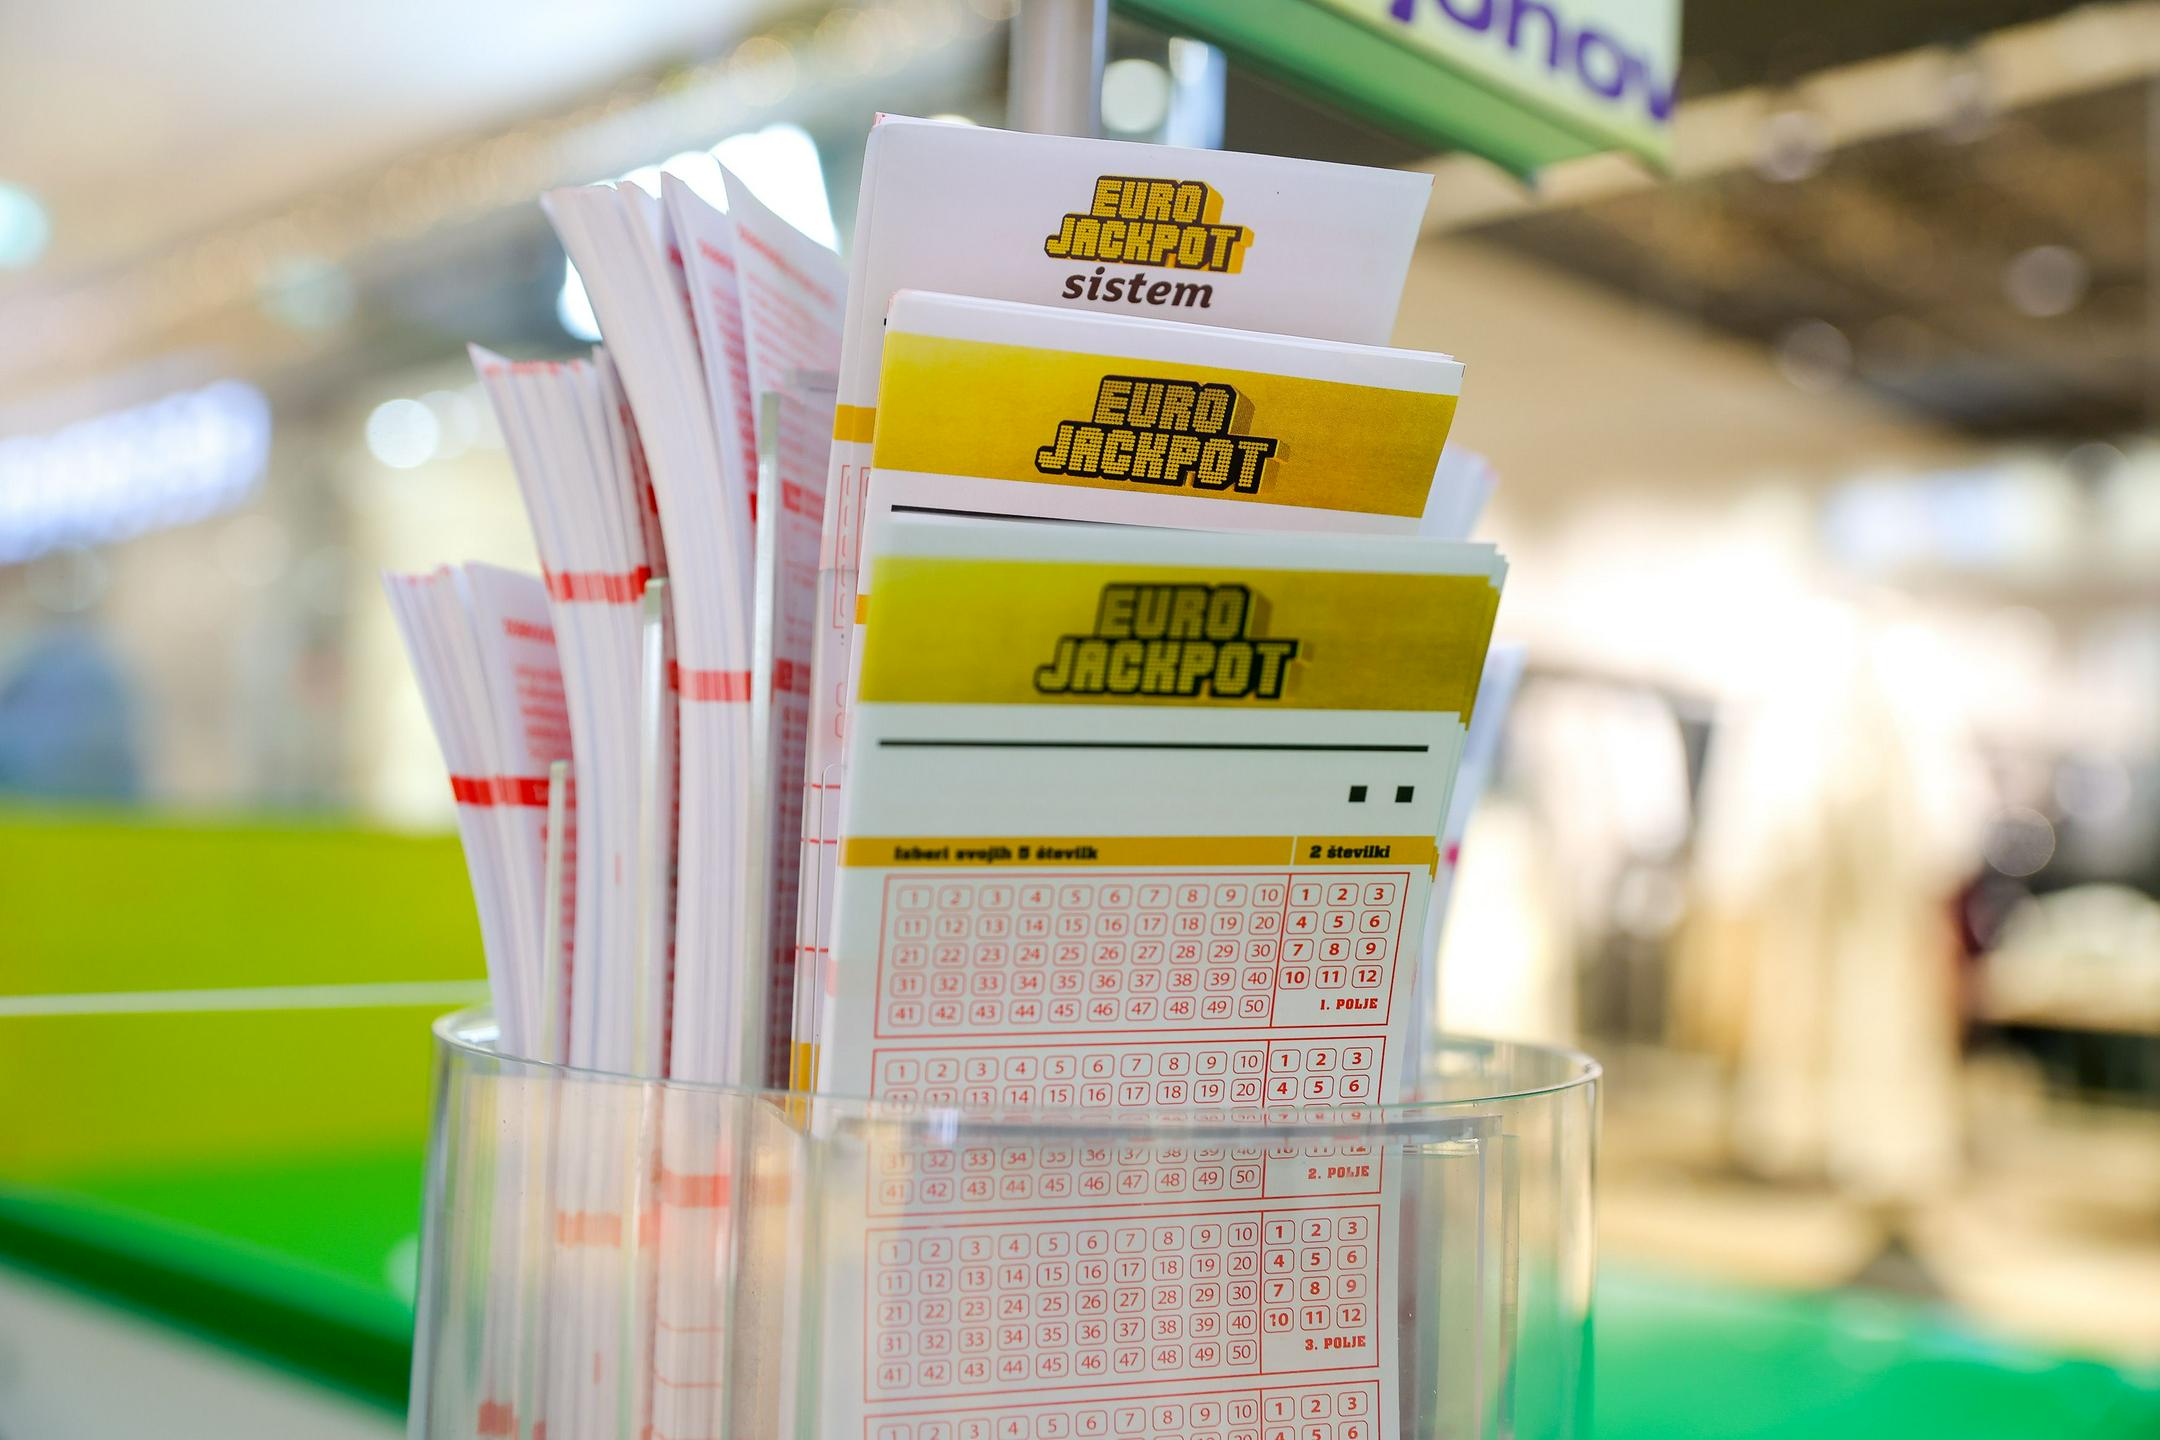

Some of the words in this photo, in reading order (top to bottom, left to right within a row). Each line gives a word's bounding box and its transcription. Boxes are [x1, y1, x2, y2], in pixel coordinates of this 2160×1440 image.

[1090, 176, 1210, 224] EURO
[1044, 214, 1245, 272] JACKPOT
[1062, 266, 1213, 308] sistem
[1093, 375, 1238, 434] EURO
[1035, 420, 1278, 493] JACKPOT
[1095, 584, 1253, 638] EURO
[1034, 635, 1299, 699] JACKPOT
[956, 846, 1012, 864] svojih
[1018, 846, 1030, 860] 5
[1036, 846, 1098, 860] številk
[1310, 845, 1322, 858] 2
[1327, 844, 1391, 858] številki
[991, 889, 1002, 905] 3
[1030, 890, 1041, 903] 4
[1071, 889, 1081, 904] 5
[1109, 889, 1121, 904] 6
[1149, 888, 1160, 903] 7
[1186, 888, 1198, 903] 8
[1225, 888, 1236, 902] 9
[1261, 888, 1278, 902] 10
[1336, 887, 1348, 901] 2
[1373, 887, 1384, 900] 3
[985, 918, 1003, 933] 13
[1025, 919, 1043, 931] 14
[1065, 917, 1083, 932] 15
[1104, 917, 1122, 931] 16
[1143, 916, 1161, 931] 17
[1182, 916, 1199, 931] 18
[1219, 916, 1237, 930] 19
[1254, 915, 1274, 929] 20
[1295, 915, 1307, 928] 4
[1332, 915, 1343, 928] 5
[1368, 914, 1380, 928] 6
[979, 947, 1000, 962] 23
[1020, 946, 1040, 961] 24
[1059, 946, 1079, 961] 25
[1098, 946, 1119, 960] 26
[1137, 944, 1157, 960] 27
[1175, 944, 1196, 959] 28
[1213, 943, 1234, 958] 29
[1251, 943, 1271, 957] 30
[1292, 943, 1303, 956] 7
[1328, 942, 1339, 956] 8
[1365, 941, 1376, 955] 9
[979, 975, 998, 990] 33
[1019, 975, 1037, 989] 34
[1057, 974, 1076, 989] 35
[1096, 974, 1116, 988] 36
[1134, 973, 1154, 987] 37
[1172, 972, 1192, 987] 38
[1210, 972, 1230, 986] 39
[1247, 971, 1267, 984] 40
[1285, 970, 1305, 984] 10
[1321, 970, 1339, 983] 11
[1358, 969, 1377, 982] 12
[975, 1004, 995, 1019] 43
[1014, 1004, 1035, 1017] 44
[1053, 1003, 1074, 1017] 45
[1092, 1002, 1113, 1016] 46
[1130, 1001, 1151, 1015] 47
[1169, 1000, 1189, 1014] 48
[1206, 1000, 1227, 1013] 49
[1244, 999, 1264, 1013] 50
[1336, 998, 1378, 1009] POLJE
[1315, 1052, 1326, 1066] 2
[1351, 1051, 1362, 1064] 3
[1276, 1081, 1288, 1095] 4
[1313, 1080, 1323, 1094] 5
[1348, 1079, 1359, 1092] 6
[1308, 1168, 1321, 1179] 2.
[1328, 1166, 1369, 1178] POLJE
[1310, 1223, 1321, 1237] 2
[1347, 1220, 1357, 1235] 3
[971, 1240, 980, 1256] 3
[1008, 1238, 1019, 1252] 4
[1047, 1236, 1058, 1251] 5
[1086, 1234, 1097, 1249] 6
[1125, 1232, 1136, 1247] 7
[1162, 1230, 1173, 1245] 8
[1200, 1228, 1211, 1243] 9
[1235, 1226, 1252, 1241] 10
[1272, 1254, 1285, 1268] 4
[1310, 1251, 1320, 1266] 5
[1346, 1249, 1357, 1264] 6
[967, 1270, 985, 1285] 13
[1006, 1268, 1023, 1283] 14
[1044, 1266, 1062, 1281] 15
[1083, 1264, 1101, 1279] 16
[1121, 1262, 1139, 1277] 17
[1159, 1259, 1177, 1275] 18
[1196, 1258, 1215, 1272] 19
[1232, 1255, 1252, 1270] 20
[1273, 1282, 1284, 1297] 7
[1309, 1280, 1320, 1295] 8
[1345, 1278, 1356, 1293] 9
[964, 1300, 984, 1317] 23
[1003, 1298, 1023, 1314] 24
[1042, 1296, 1062, 1312] 25
[1081, 1294, 1101, 1309] 26
[1119, 1291, 1139, 1307] 27
[1157, 1289, 1176, 1304] 28
[1194, 1287, 1214, 1302] 29
[1232, 1285, 1251, 1300] 30
[1268, 1312, 1289, 1327] 10
[1305, 1310, 1322, 1324] 11
[1341, 1307, 1361, 1322] 12
[965, 1331, 984, 1347] 33
[1003, 1328, 1023, 1344] 34
[1042, 1326, 1062, 1342] 35
[1081, 1324, 1101, 1339] 36
[1119, 1321, 1138, 1337] 37
[1157, 1319, 1176, 1334] 38
[1194, 1316, 1214, 1332] 39
[1231, 1314, 1251, 1329] 40
[1305, 1339, 1318, 1350] 3.
[1324, 1336, 1366, 1349] POLJE
[964, 1362, 984, 1377] 43
[1002, 1359, 1023, 1374] 44
[1041, 1356, 1062, 1372] 45
[1080, 1354, 1101, 1369] 46
[1119, 1351, 1138, 1367] 47
[1156, 1349, 1176, 1364] 48
[1194, 1346, 1214, 1361] 49
[1232, 1344, 1251, 1359] 50
